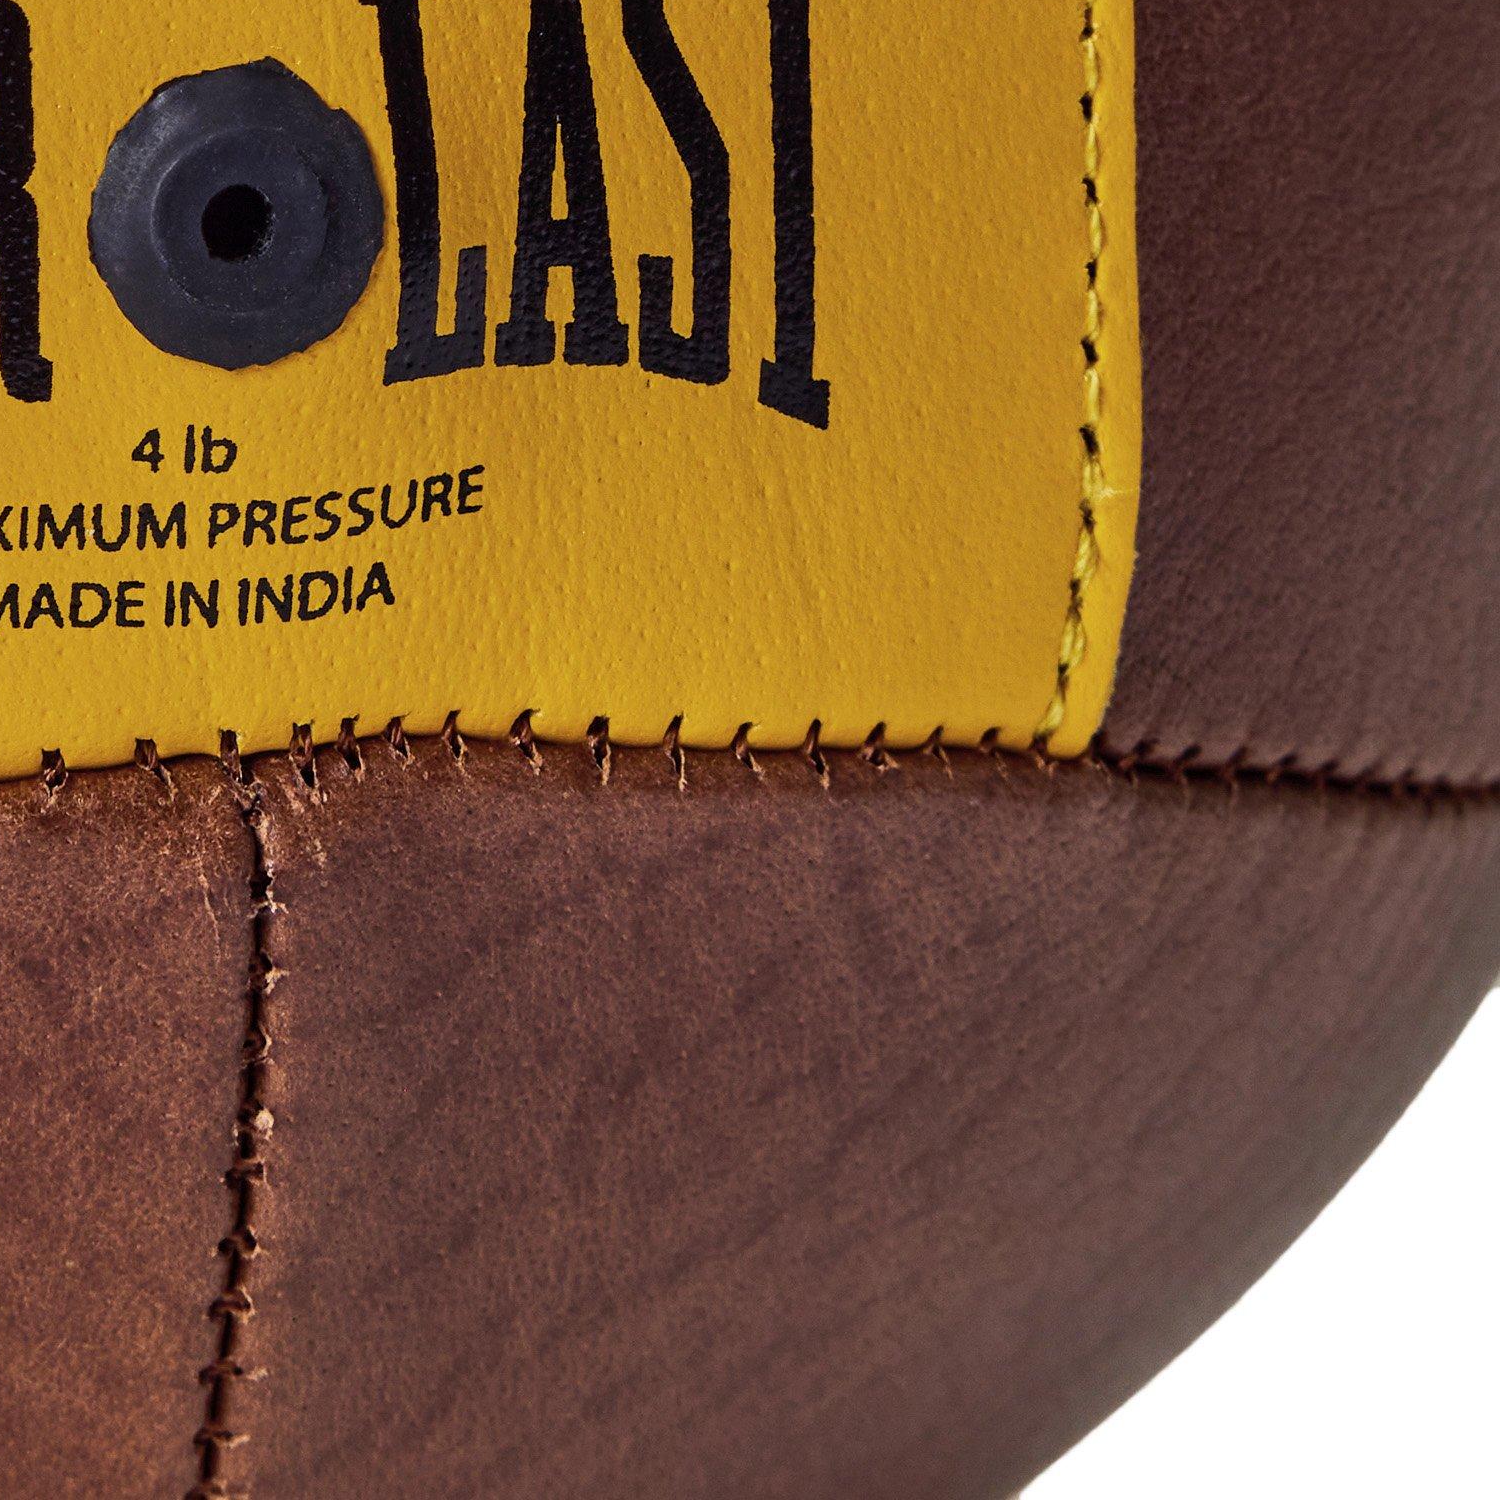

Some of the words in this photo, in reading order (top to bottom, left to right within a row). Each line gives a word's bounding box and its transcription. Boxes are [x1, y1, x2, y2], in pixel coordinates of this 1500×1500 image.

[131, 427, 165, 474] 4
[183, 424, 238, 475] lb
[207, 464, 486, 550] PRESSURE
[163, 578, 220, 629] IN
[237, 561, 396, 627] INDIA
